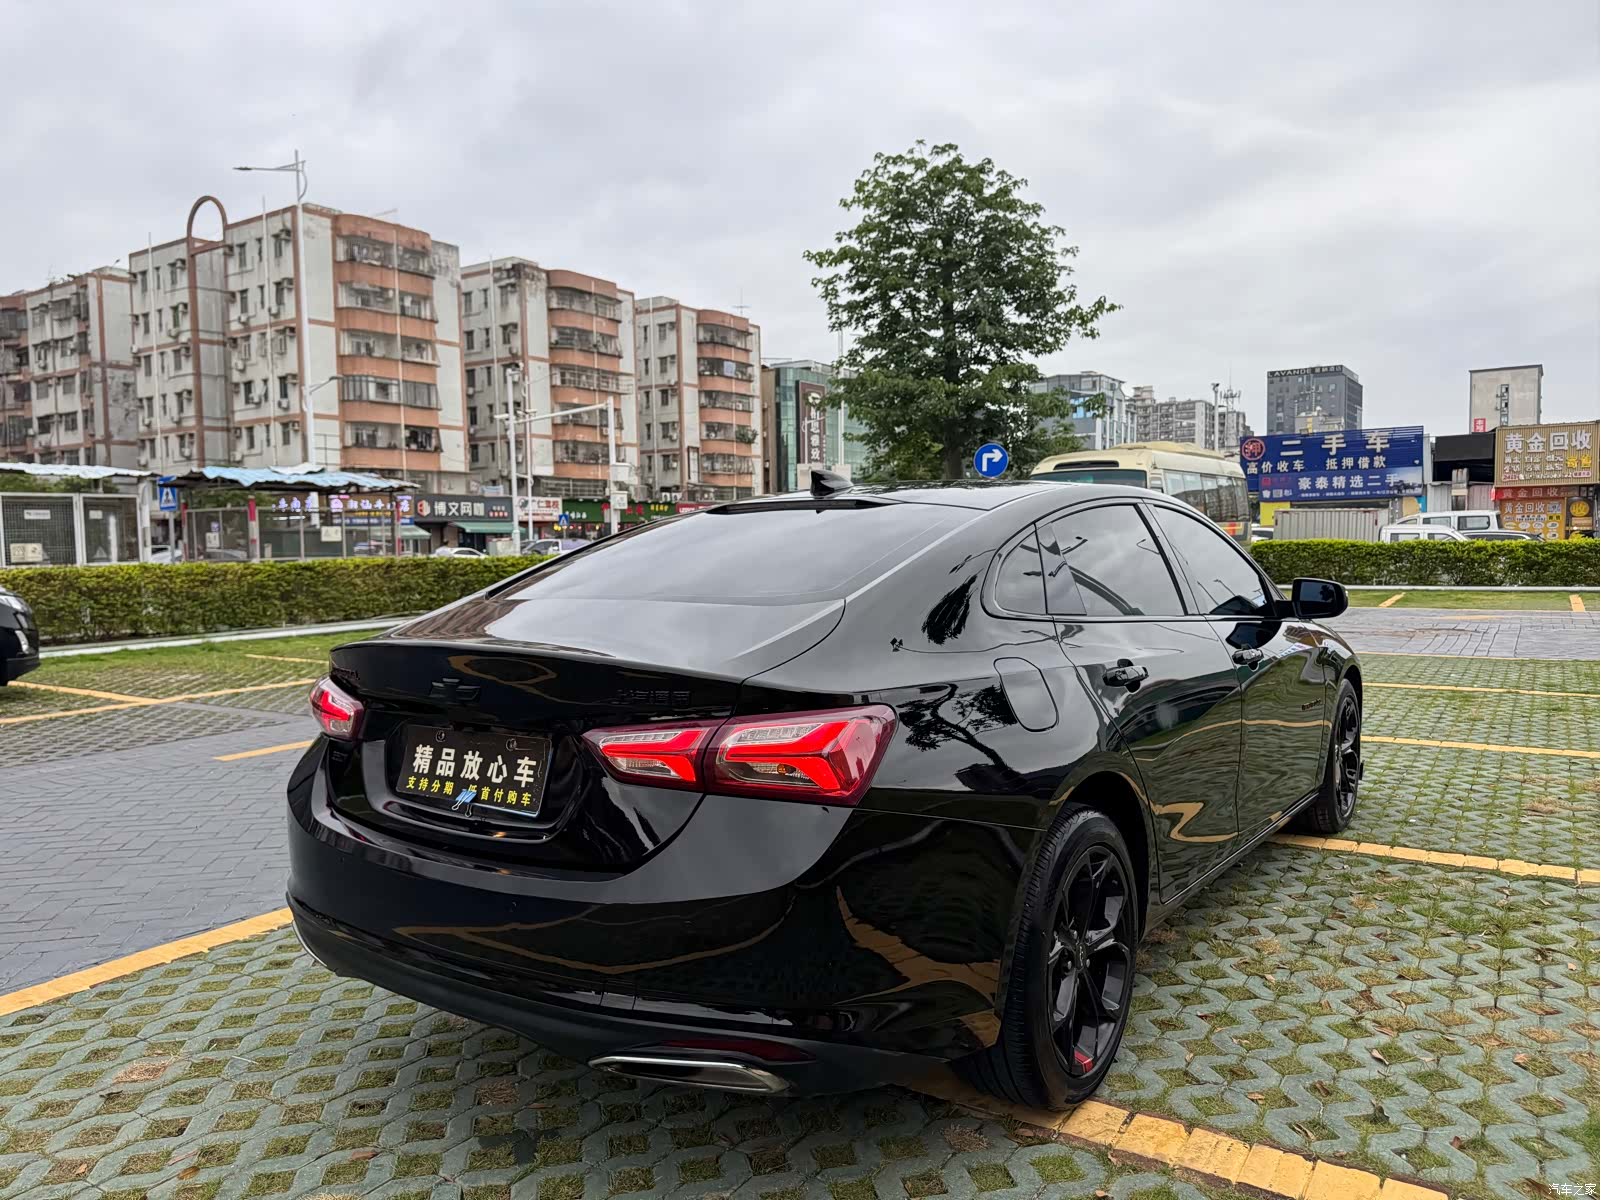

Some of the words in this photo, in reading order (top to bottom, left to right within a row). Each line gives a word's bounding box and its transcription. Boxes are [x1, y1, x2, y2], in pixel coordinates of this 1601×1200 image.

[1268, 368, 1312, 377] LAVANDE
[1280, 431, 1390, 456] 二手车
[1505, 429, 1592, 454] 黄金回收
[1246, 459, 1305, 475] 高价收车
[1326, 455, 1386, 471] 抵押借款
[1298, 473, 1415, 490] 豪泰精选二手
[1502, 487, 1559, 498] 黄金回收
[1504, 502, 1545, 514] 黄金回收
[412, 743, 537, 788] 精品放心车
[406, 775, 456, 796] 支持分期
